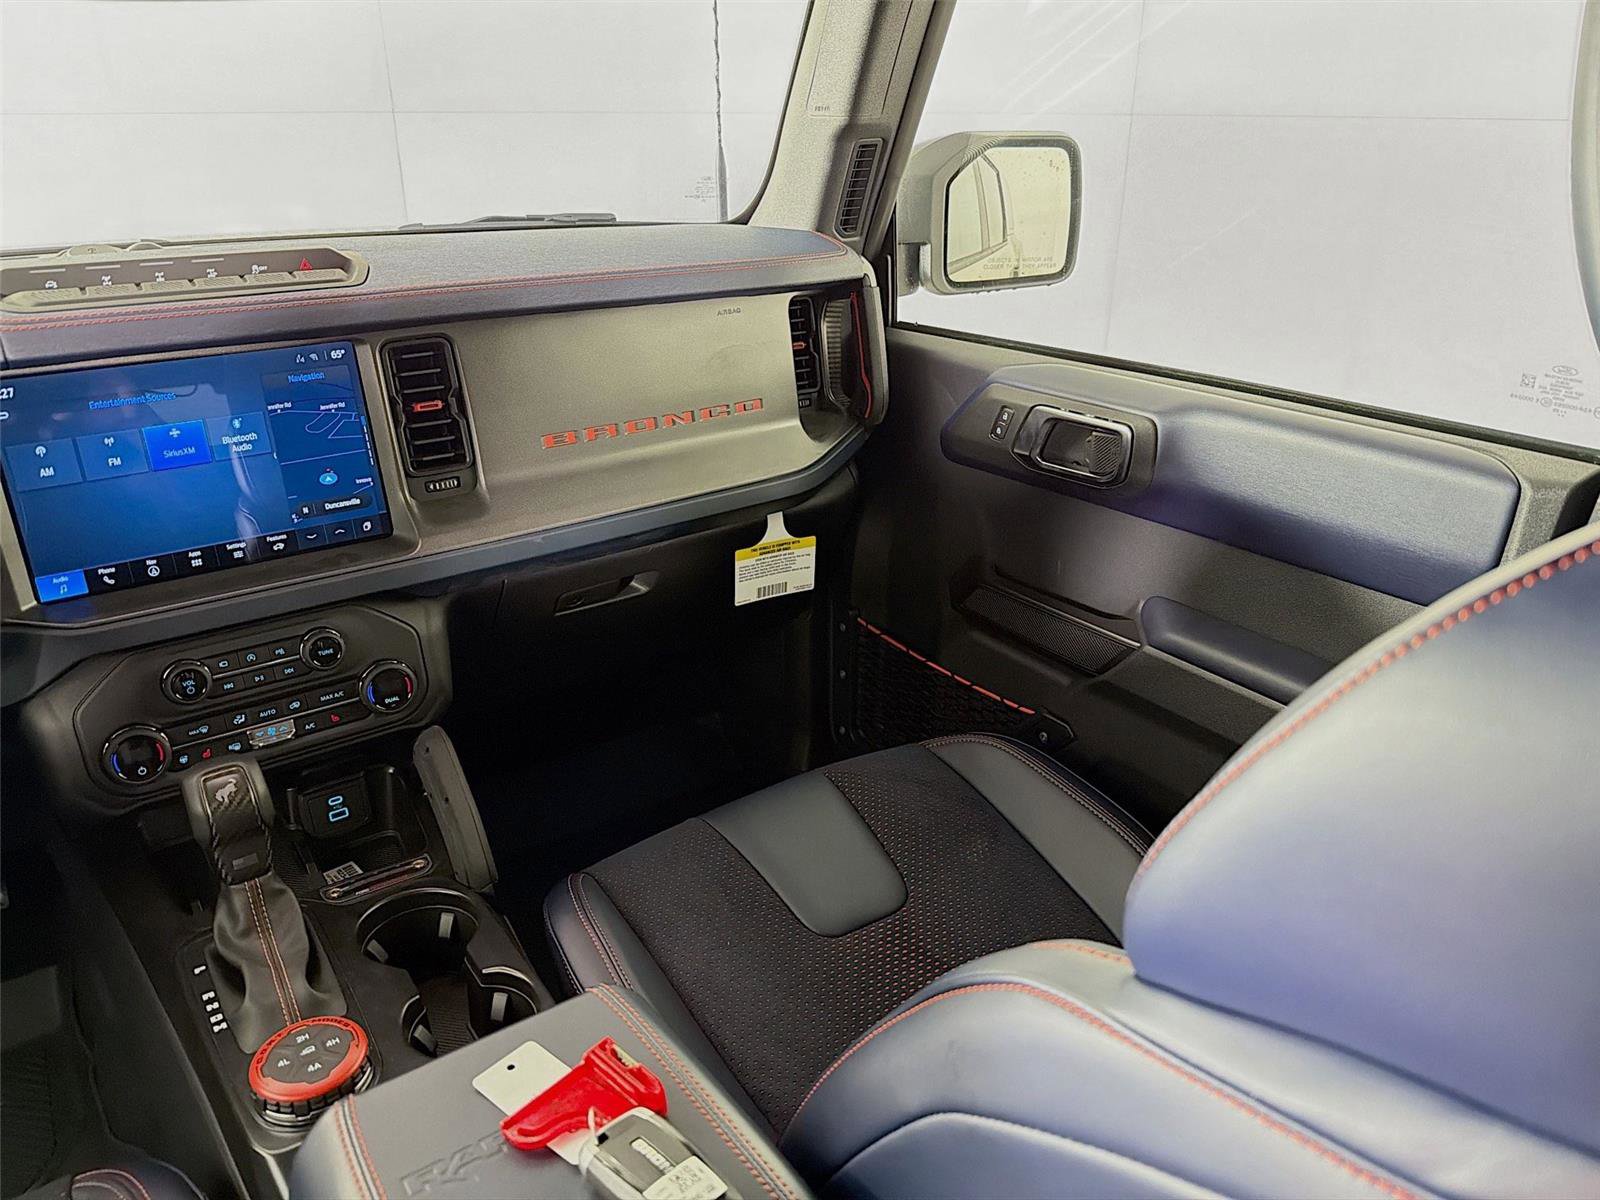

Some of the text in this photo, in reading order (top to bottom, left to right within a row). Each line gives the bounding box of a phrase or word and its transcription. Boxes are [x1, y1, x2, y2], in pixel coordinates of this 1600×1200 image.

[287, 371, 325, 383] Navigation
[88, 391, 176, 409] Entertainment Sources
[541, 397, 762, 449] BRONCO
[221, 431, 258, 445] Bluetooth
[163, 446, 196, 459] SiriusXM
[231, 443, 253, 453] Audio
[107, 456, 122, 467] FM
[39, 465, 55, 477] AM
[324, 497, 361, 511] Duncansville
[266, 533, 288, 543] Features
[226, 541, 247, 551] Settings
[188, 550, 202, 558] Apps
[97, 566, 116, 575] Phone
[52, 575, 69, 585] Audio
[182, 679, 196, 687] VOL
[320, 690, 345, 702] MAX A/C
[259, 708, 277, 718] AUTO
[304, 722, 317, 731] A/C
[295, 1032, 310, 1044] 2H
[325, 1036, 341, 1048] 4H
[277, 1058, 291, 1068] 4L
[307, 1062, 323, 1073] 4A
